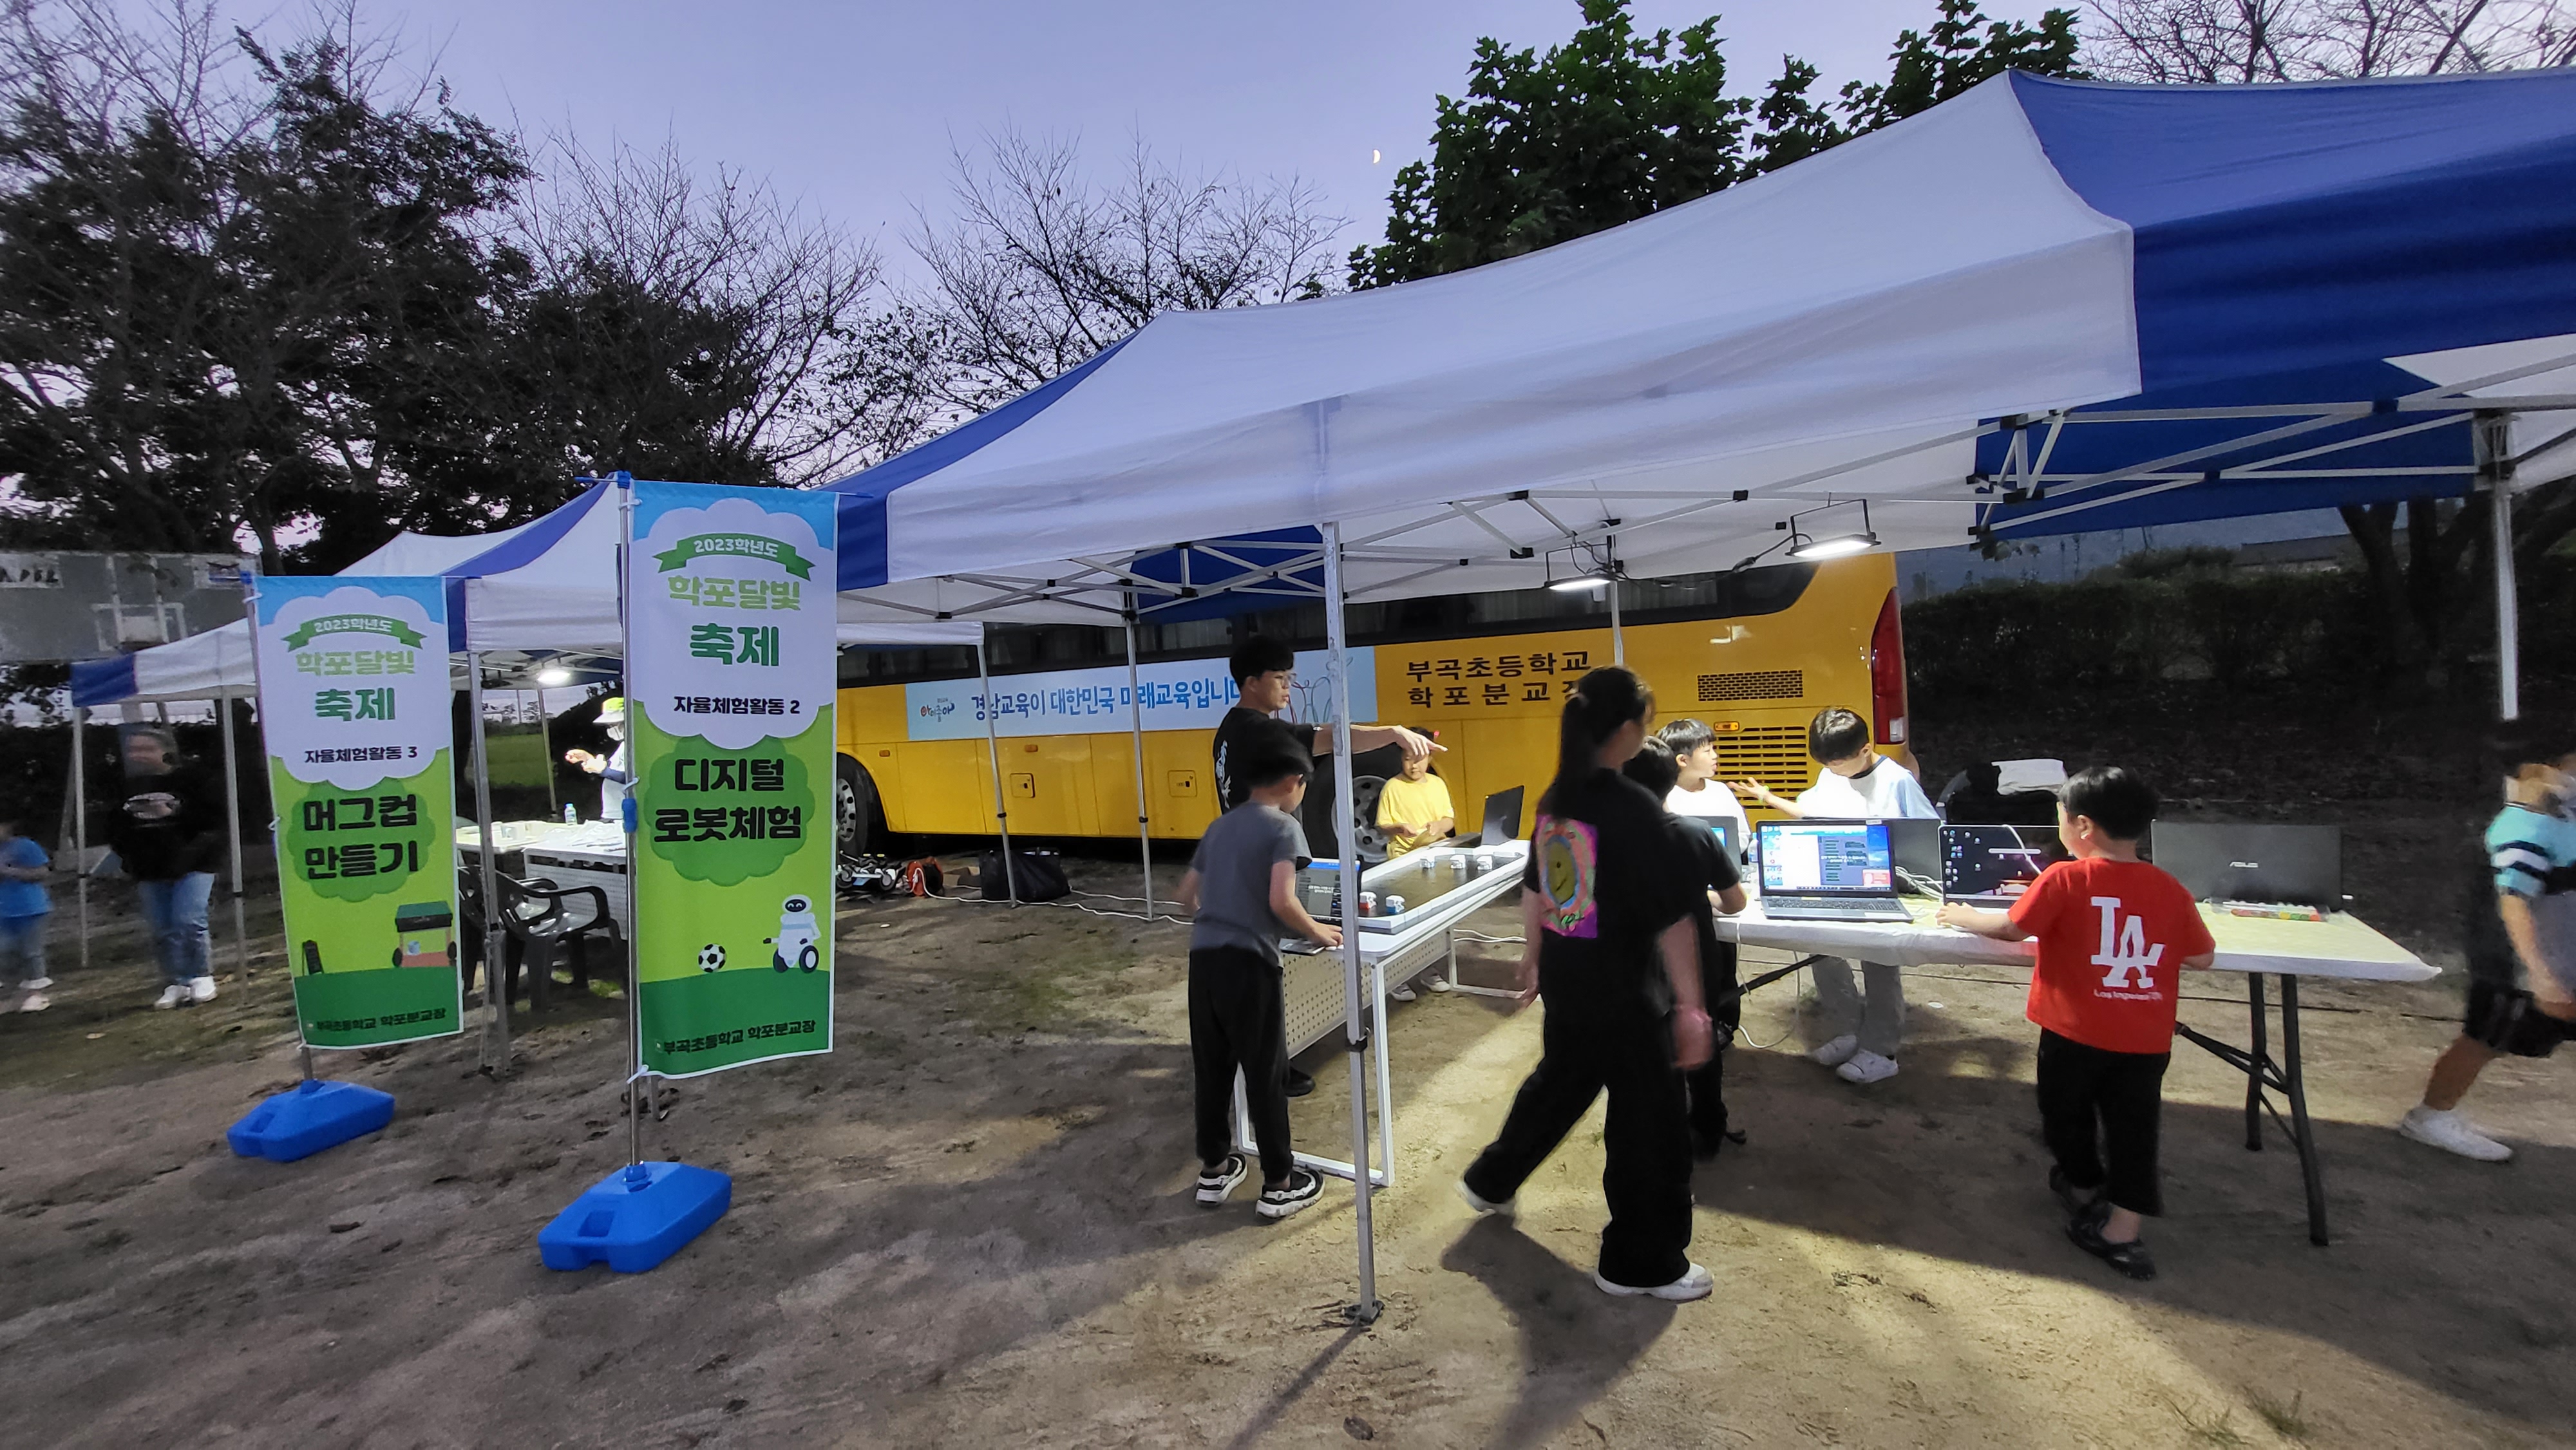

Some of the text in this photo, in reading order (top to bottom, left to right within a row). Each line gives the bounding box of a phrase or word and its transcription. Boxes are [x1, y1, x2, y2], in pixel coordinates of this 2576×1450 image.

[694, 538, 779, 558] 2023학년도
[668, 575, 801, 610] 학포달빛
[314, 618, 393, 632] 2023학년도
[690, 623, 779, 666] 축제
[296, 650, 416, 676] 학포달빛
[1406, 650, 1591, 683] 부곡초등학교
[314, 687, 396, 722] 축제
[674, 695, 800, 715] 자율체험활동 2
[1050, 685, 1115, 716] 대한민국
[305, 746, 418, 764] 자율체험활동 3
[674, 758, 785, 793] 디지털
[304, 794, 417, 831] 머그컵
[654, 805, 802, 843] 로봇체험
[305, 840, 419, 880] 만들기
[2090, 896, 2166, 988] LA
[380, 1008, 447, 1026] 학포분교장
[664, 1019, 816, 1055] 부곡초등학교 학포분교장
